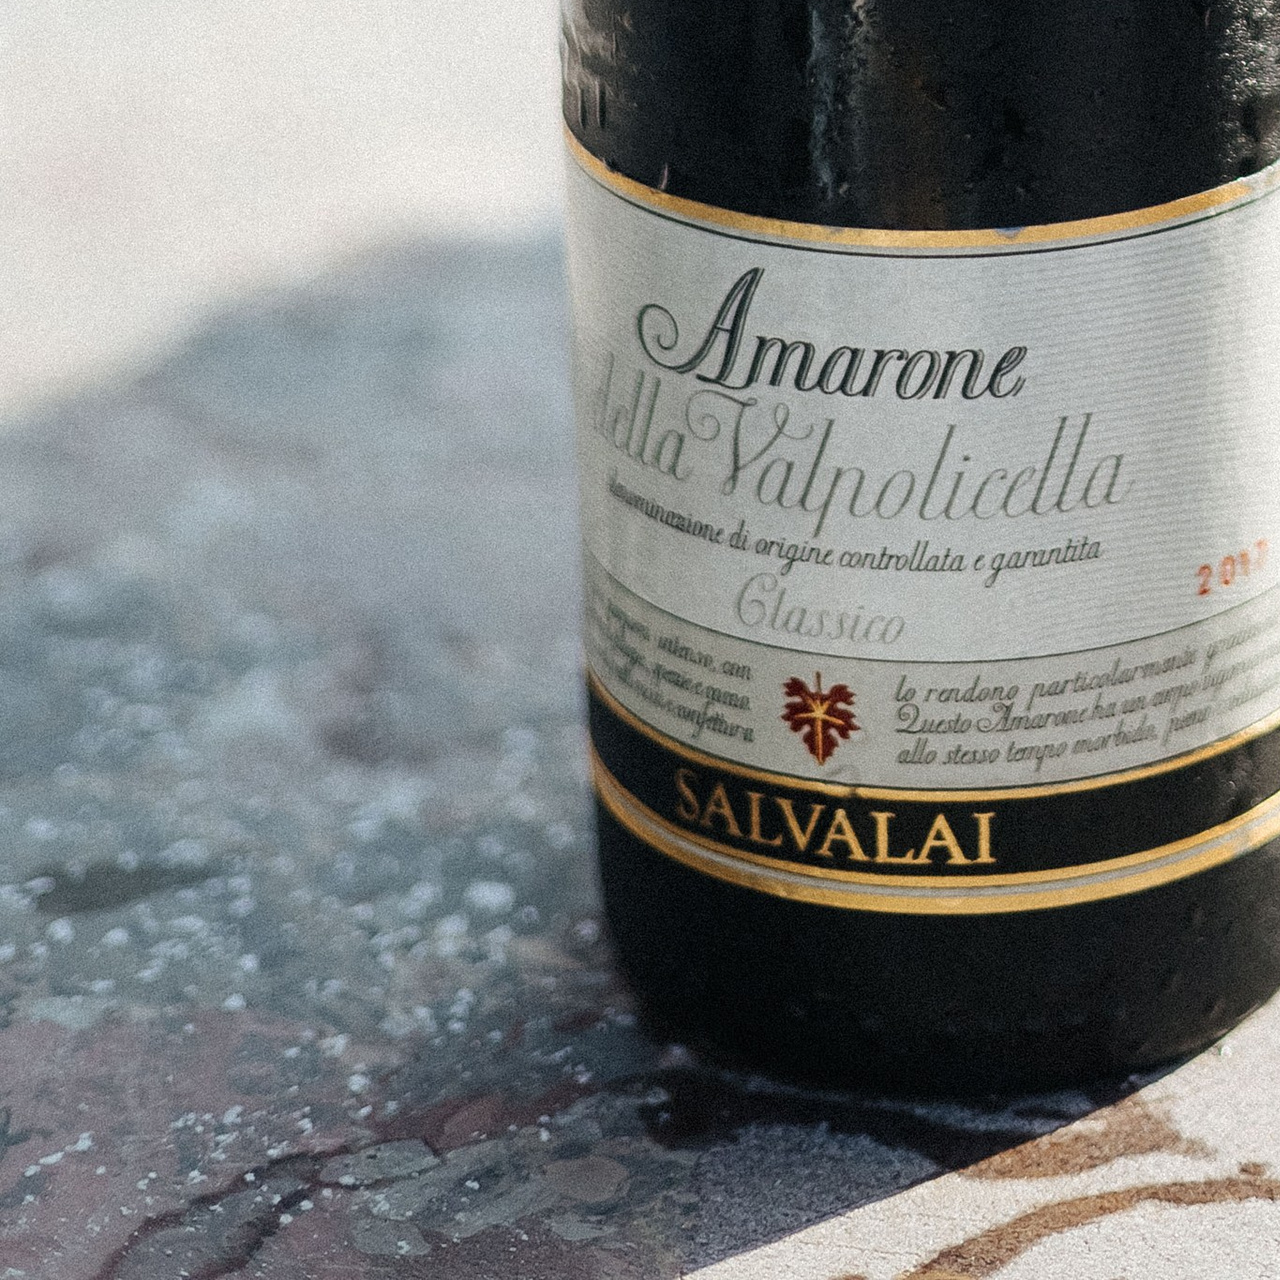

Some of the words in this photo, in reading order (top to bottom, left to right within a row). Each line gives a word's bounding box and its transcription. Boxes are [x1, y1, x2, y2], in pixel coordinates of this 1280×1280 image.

[636, 266, 1028, 401] Amarone
[685, 389, 1136, 539] Valpolicella
[729, 519, 750, 551] di
[755, 540, 833, 577] origine
[839, 540, 966, 572] controllata
[973, 554, 986, 572] e
[984, 536, 1103, 589] garantita
[737, 572, 906, 645] Classico
[896, 703, 973, 734] Questo
[976, 702, 1088, 733] Amarone
[923, 675, 1020, 702] rendono
[896, 737, 938, 765] allo
[942, 744, 1000, 765] stesso
[1006, 741, 1069, 772] tempo
[674, 768, 997, 866] SALVALAI
